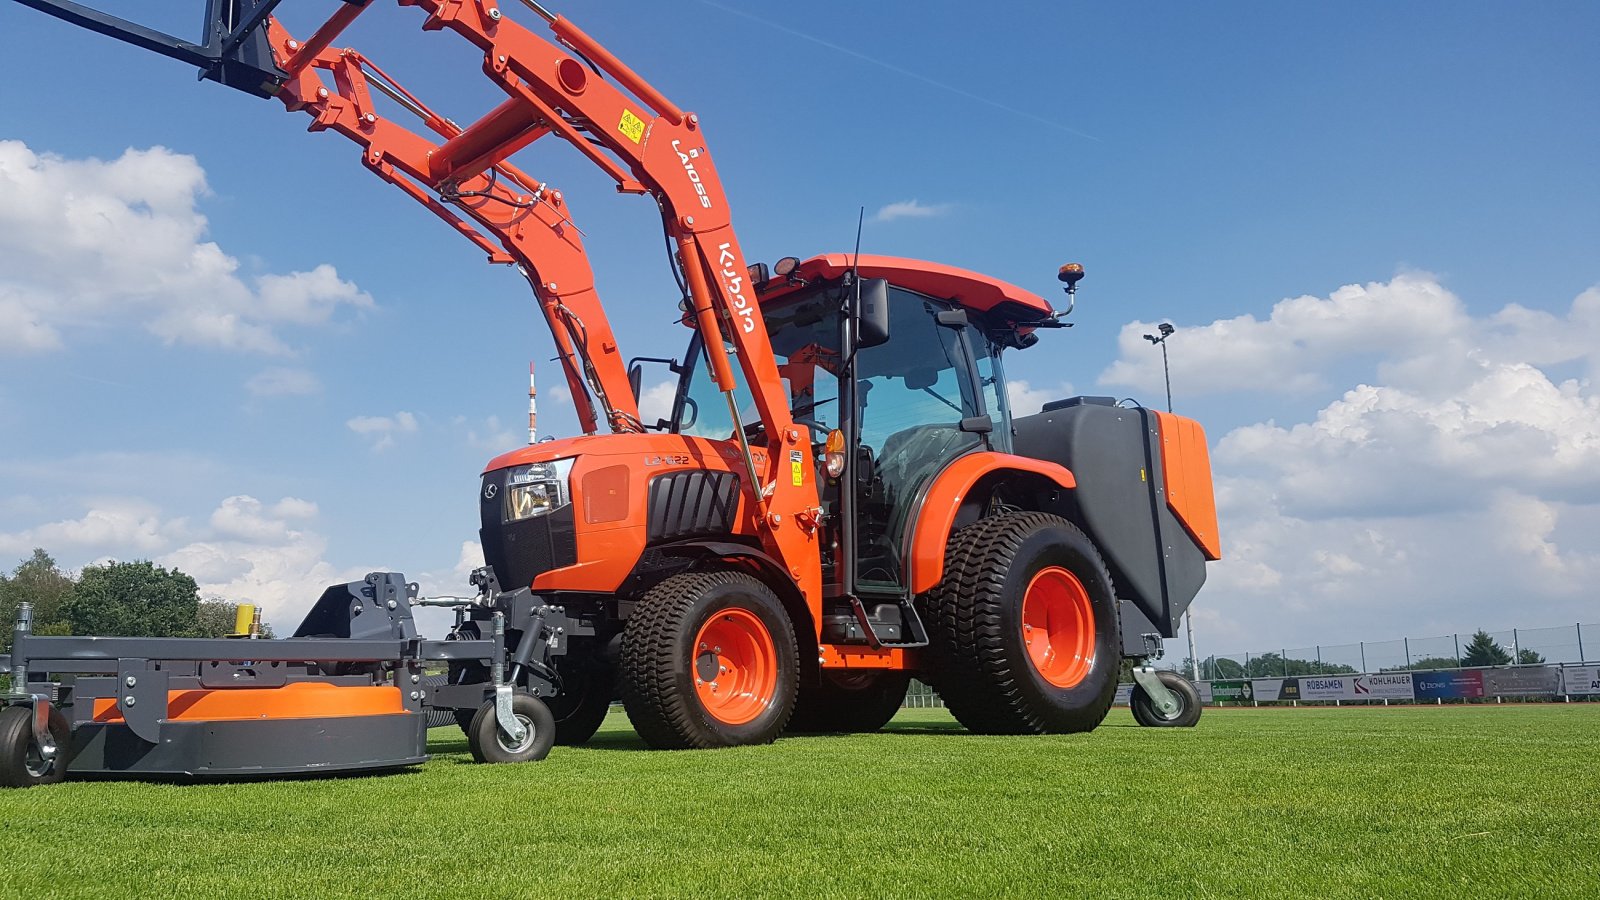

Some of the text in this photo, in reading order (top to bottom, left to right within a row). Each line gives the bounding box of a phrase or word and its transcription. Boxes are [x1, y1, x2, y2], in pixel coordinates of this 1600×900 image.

[671, 139, 712, 208] LA1055
[719, 242, 755, 333] Kubota
[644, 454, 690, 467] L2-622
[1369, 676, 1411, 686] KOHLHAUER
